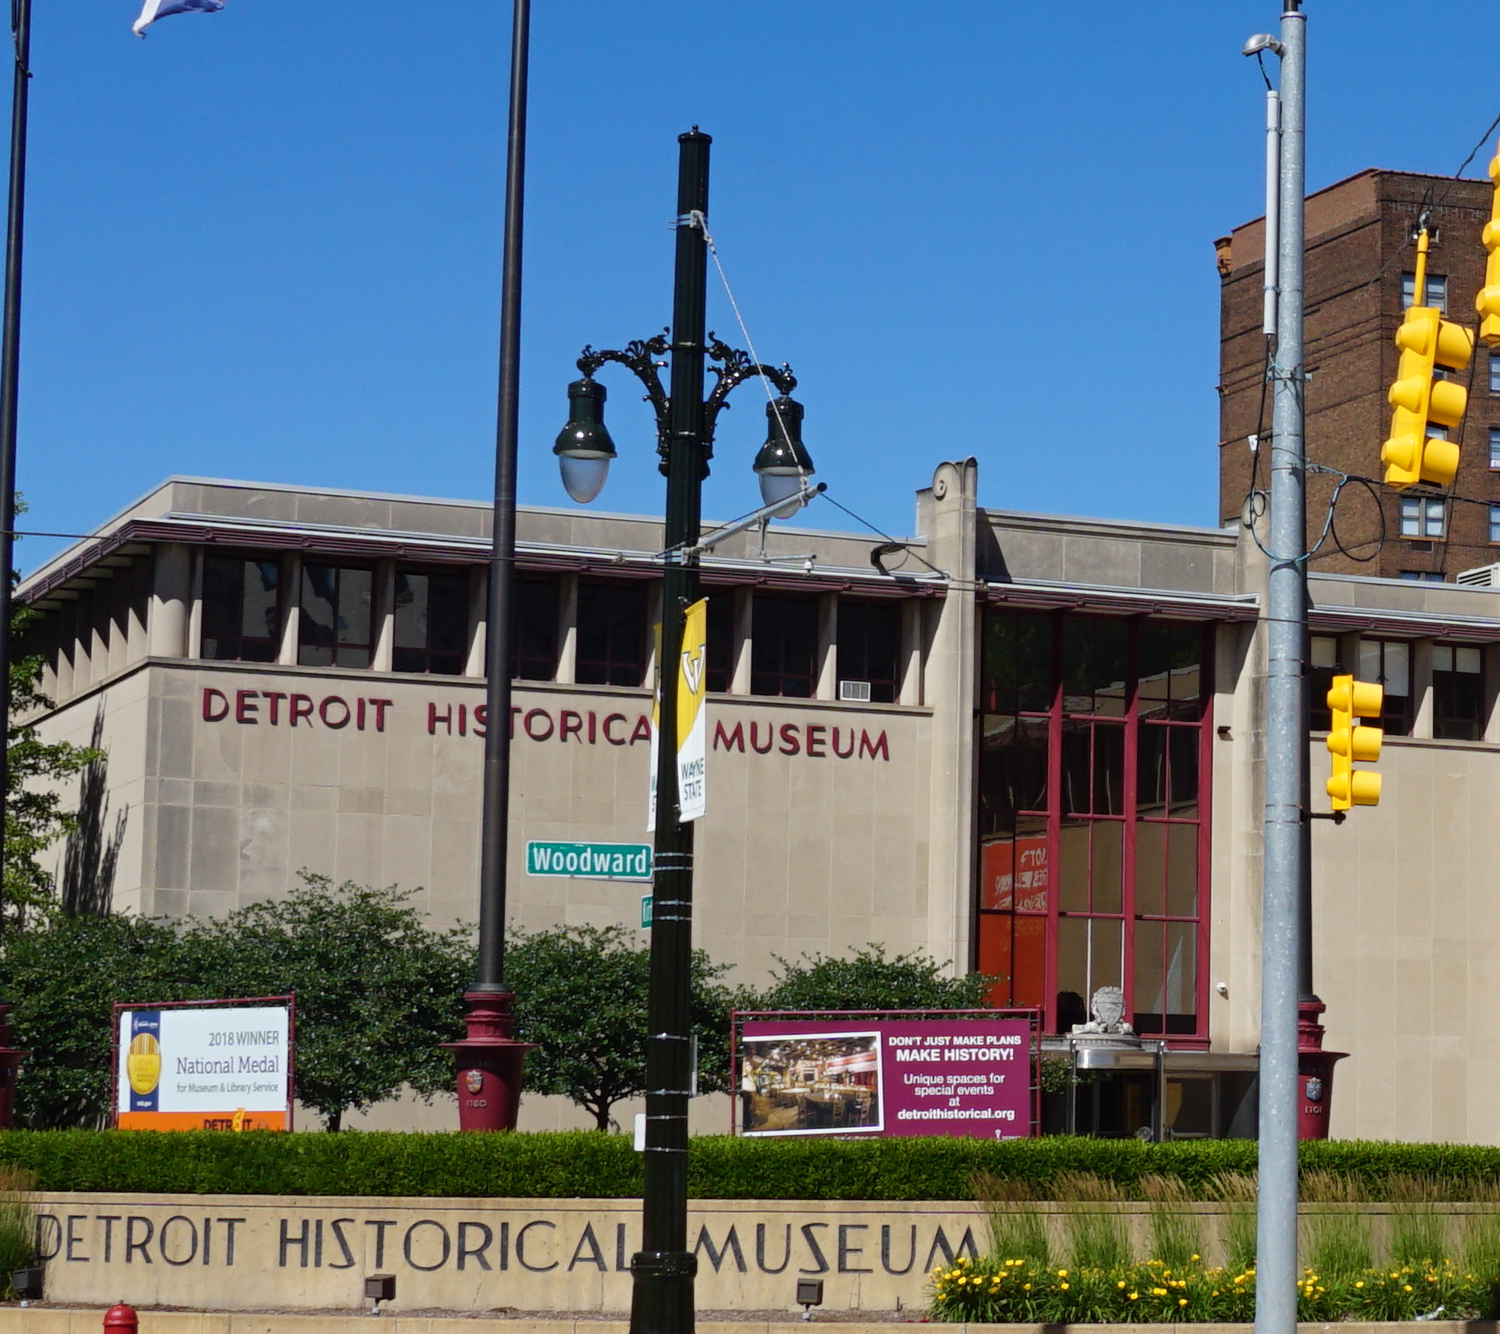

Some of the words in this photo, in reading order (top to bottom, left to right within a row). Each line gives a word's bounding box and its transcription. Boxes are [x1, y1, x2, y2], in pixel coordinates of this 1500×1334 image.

[202, 687, 393, 732] DETROIT
[428, 702, 651, 746] HISTORICA
[713, 719, 890, 762] MUSEUM
[681, 757, 704, 781] WAYNE
[684, 780, 702, 802] STATE
[533, 846, 647, 874] Woodward
[209, 1032, 235, 1046] 2018
[236, 1030, 279, 1046] WINNER
[889, 1036, 922, 1046] DON'T
[924, 1036, 951, 1046] JUST
[953, 1036, 985, 1046] MAKE
[986, 1035, 1021, 1045] PLANS
[896, 1049, 941, 1062] MAKE
[944, 1048, 1014, 1062] HISTORY!
[176, 1056, 234, 1075] National
[238, 1055, 279, 1074] Medal
[904, 1073, 944, 1086] Unique
[946, 1076, 986, 1086] spaces
[989, 1073, 1005, 1084] for
[176, 1083, 187, 1093] for
[188, 1083, 219, 1093] Museum
[220, 1083, 226, 1092] &
[227, 1082, 252, 1094] Library
[252, 1082, 279, 1093] Service
[914, 1084, 954, 1097] special
[957, 1085, 994, 1095] events
[949, 1097, 960, 1107] at
[897, 1108, 1015, 1121] detroithistorical.org
[35, 1214, 246, 1266] DETROIT
[279, 1218, 634, 1272] HISTORICAL
[694, 1222, 980, 1275] MUSEUM
